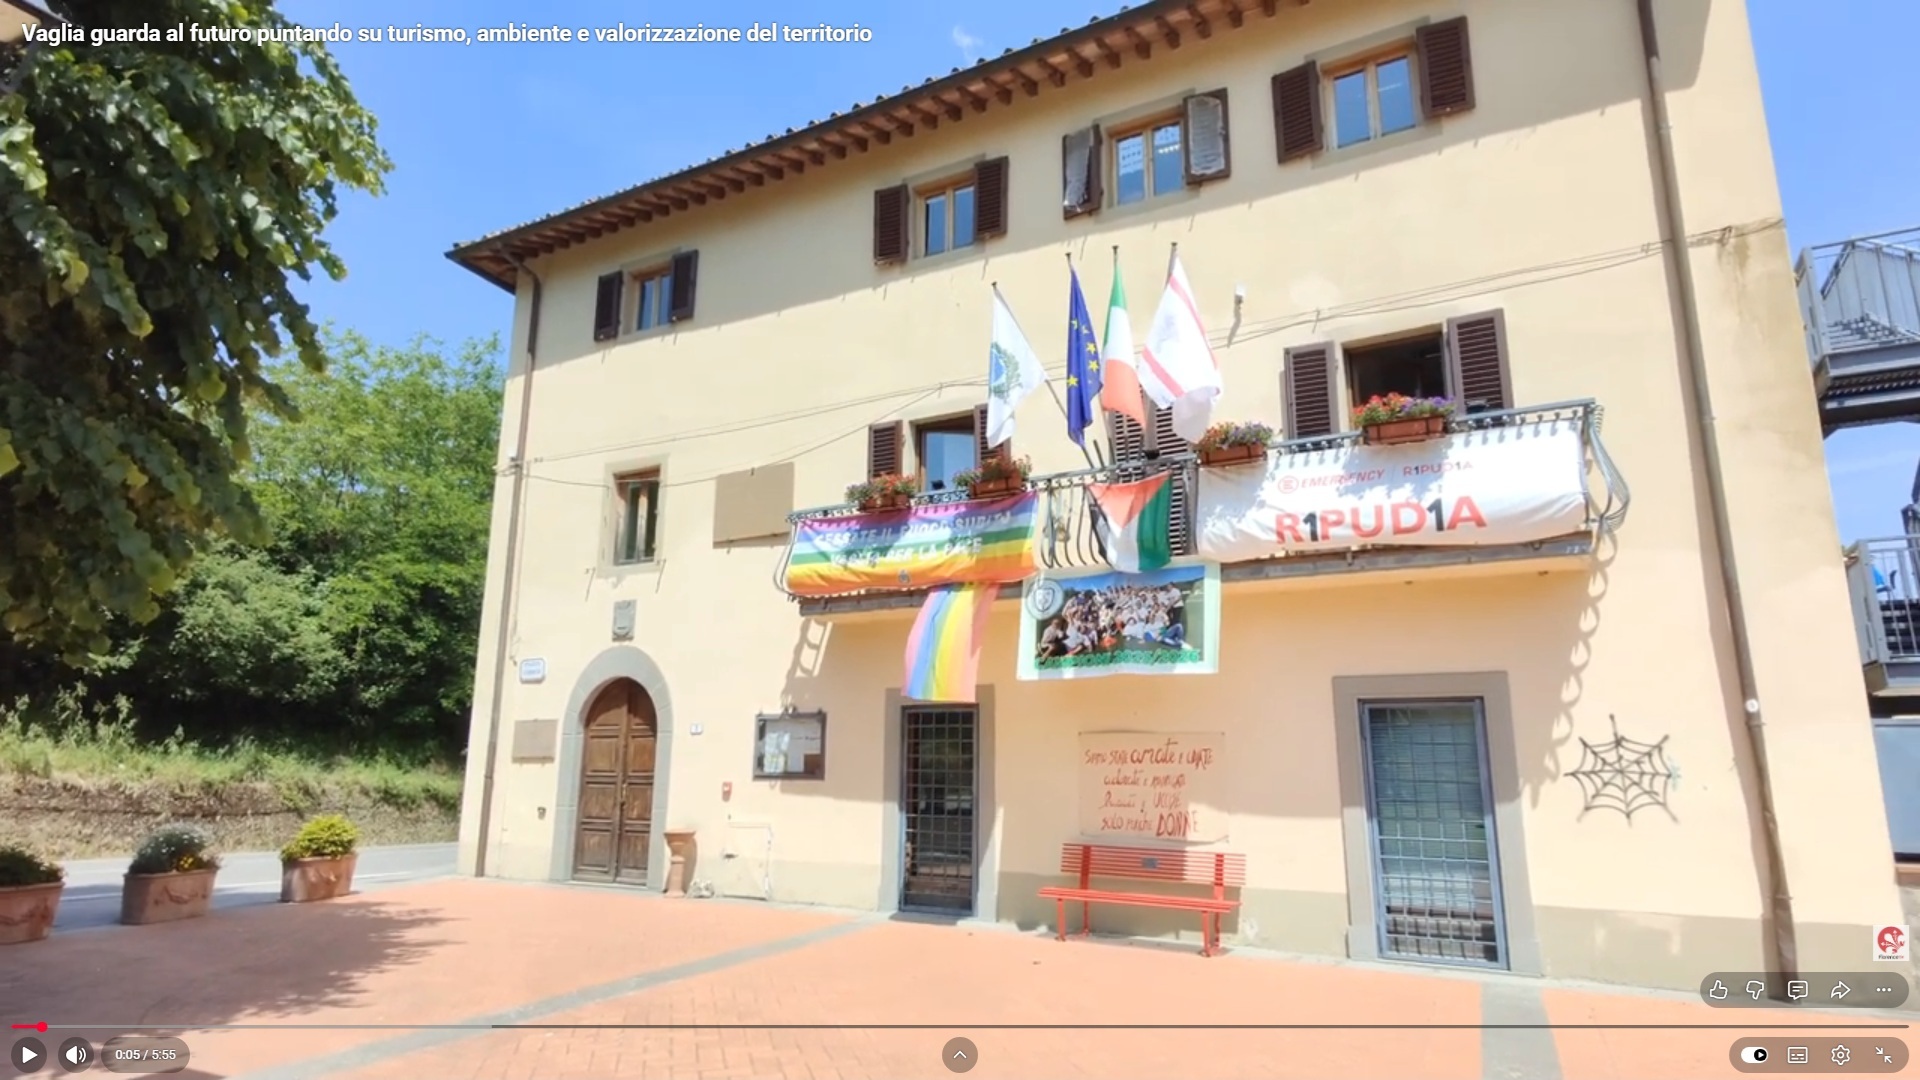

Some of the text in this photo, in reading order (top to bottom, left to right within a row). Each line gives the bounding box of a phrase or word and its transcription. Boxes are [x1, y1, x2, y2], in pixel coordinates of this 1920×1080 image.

[1301, 469, 1385, 488] EMERGENCY
[814, 511, 1011, 549] CESSATE IL FUOCO SUBITO
[1275, 496, 1487, 544] R1PUD1A
[919, 544, 938, 559] LA
[1155, 810, 1200, 837] DONNE
